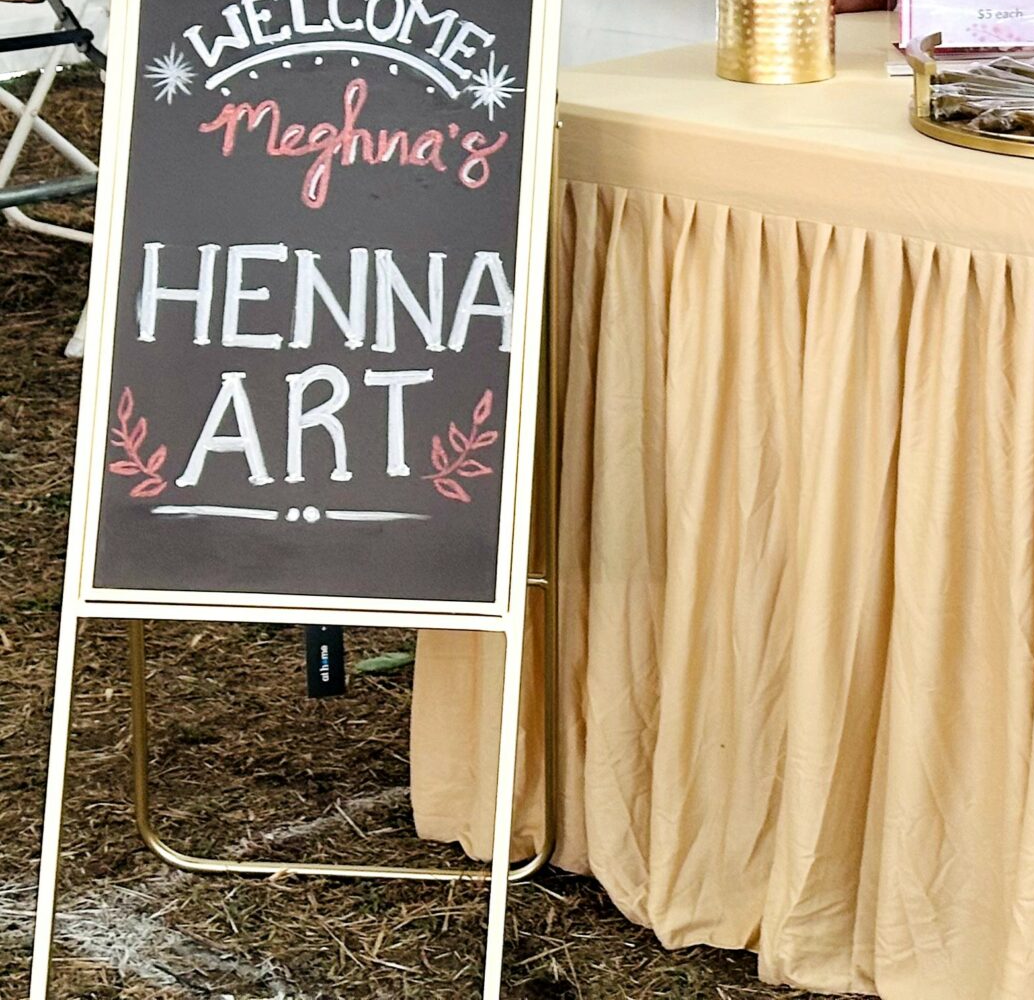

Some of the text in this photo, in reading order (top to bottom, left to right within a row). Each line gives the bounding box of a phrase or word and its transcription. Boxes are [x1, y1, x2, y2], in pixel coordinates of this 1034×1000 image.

[995, 8, 1023, 20] each
[199, 78, 509, 208] Meghna's
[137, 243, 513, 353] HENNA
[176, 364, 433, 487] ART
